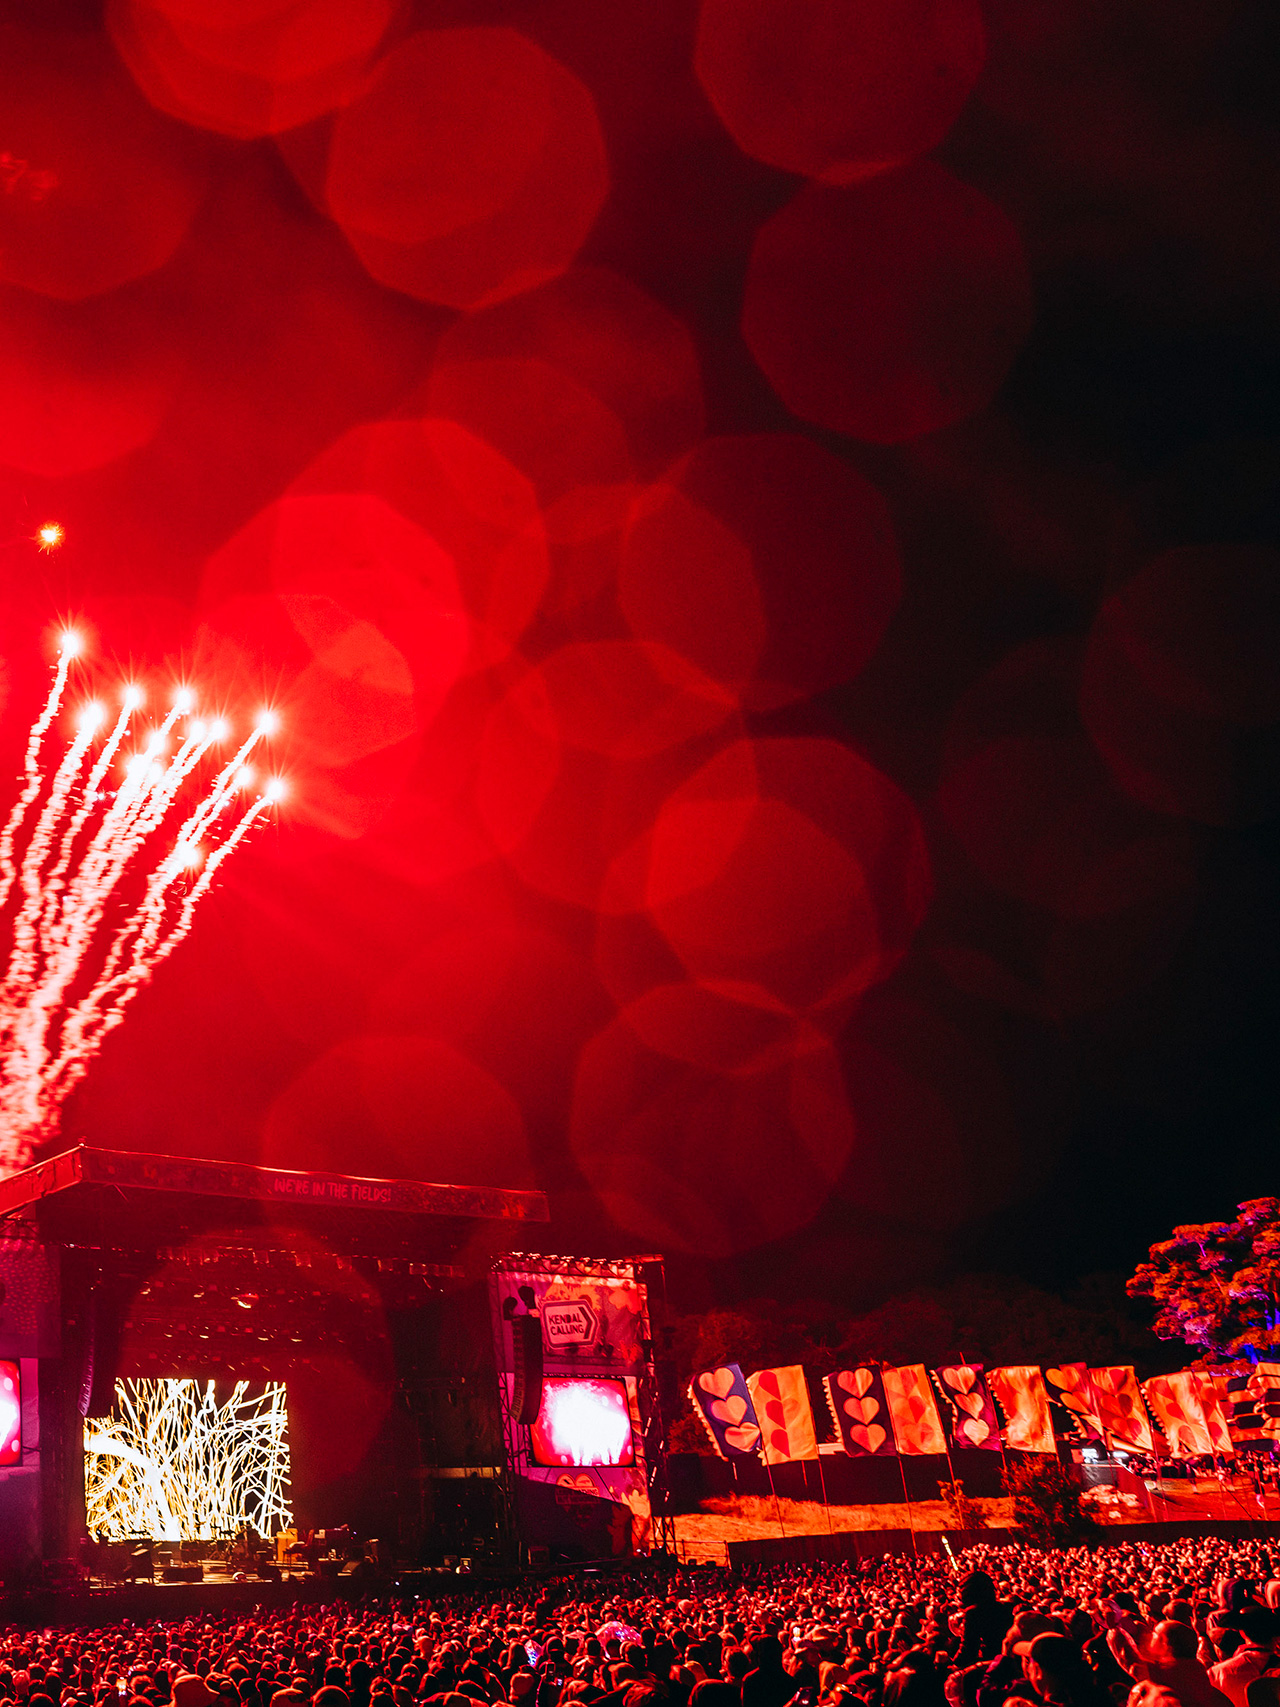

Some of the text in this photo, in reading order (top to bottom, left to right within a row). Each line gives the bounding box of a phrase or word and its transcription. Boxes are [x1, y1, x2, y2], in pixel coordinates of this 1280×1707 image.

[274, 1178, 391, 1202] WE'RE IN THE FIELDS!
[548, 1313, 583, 1325] KENDAL
[550, 1324, 585, 1335] CALLING
